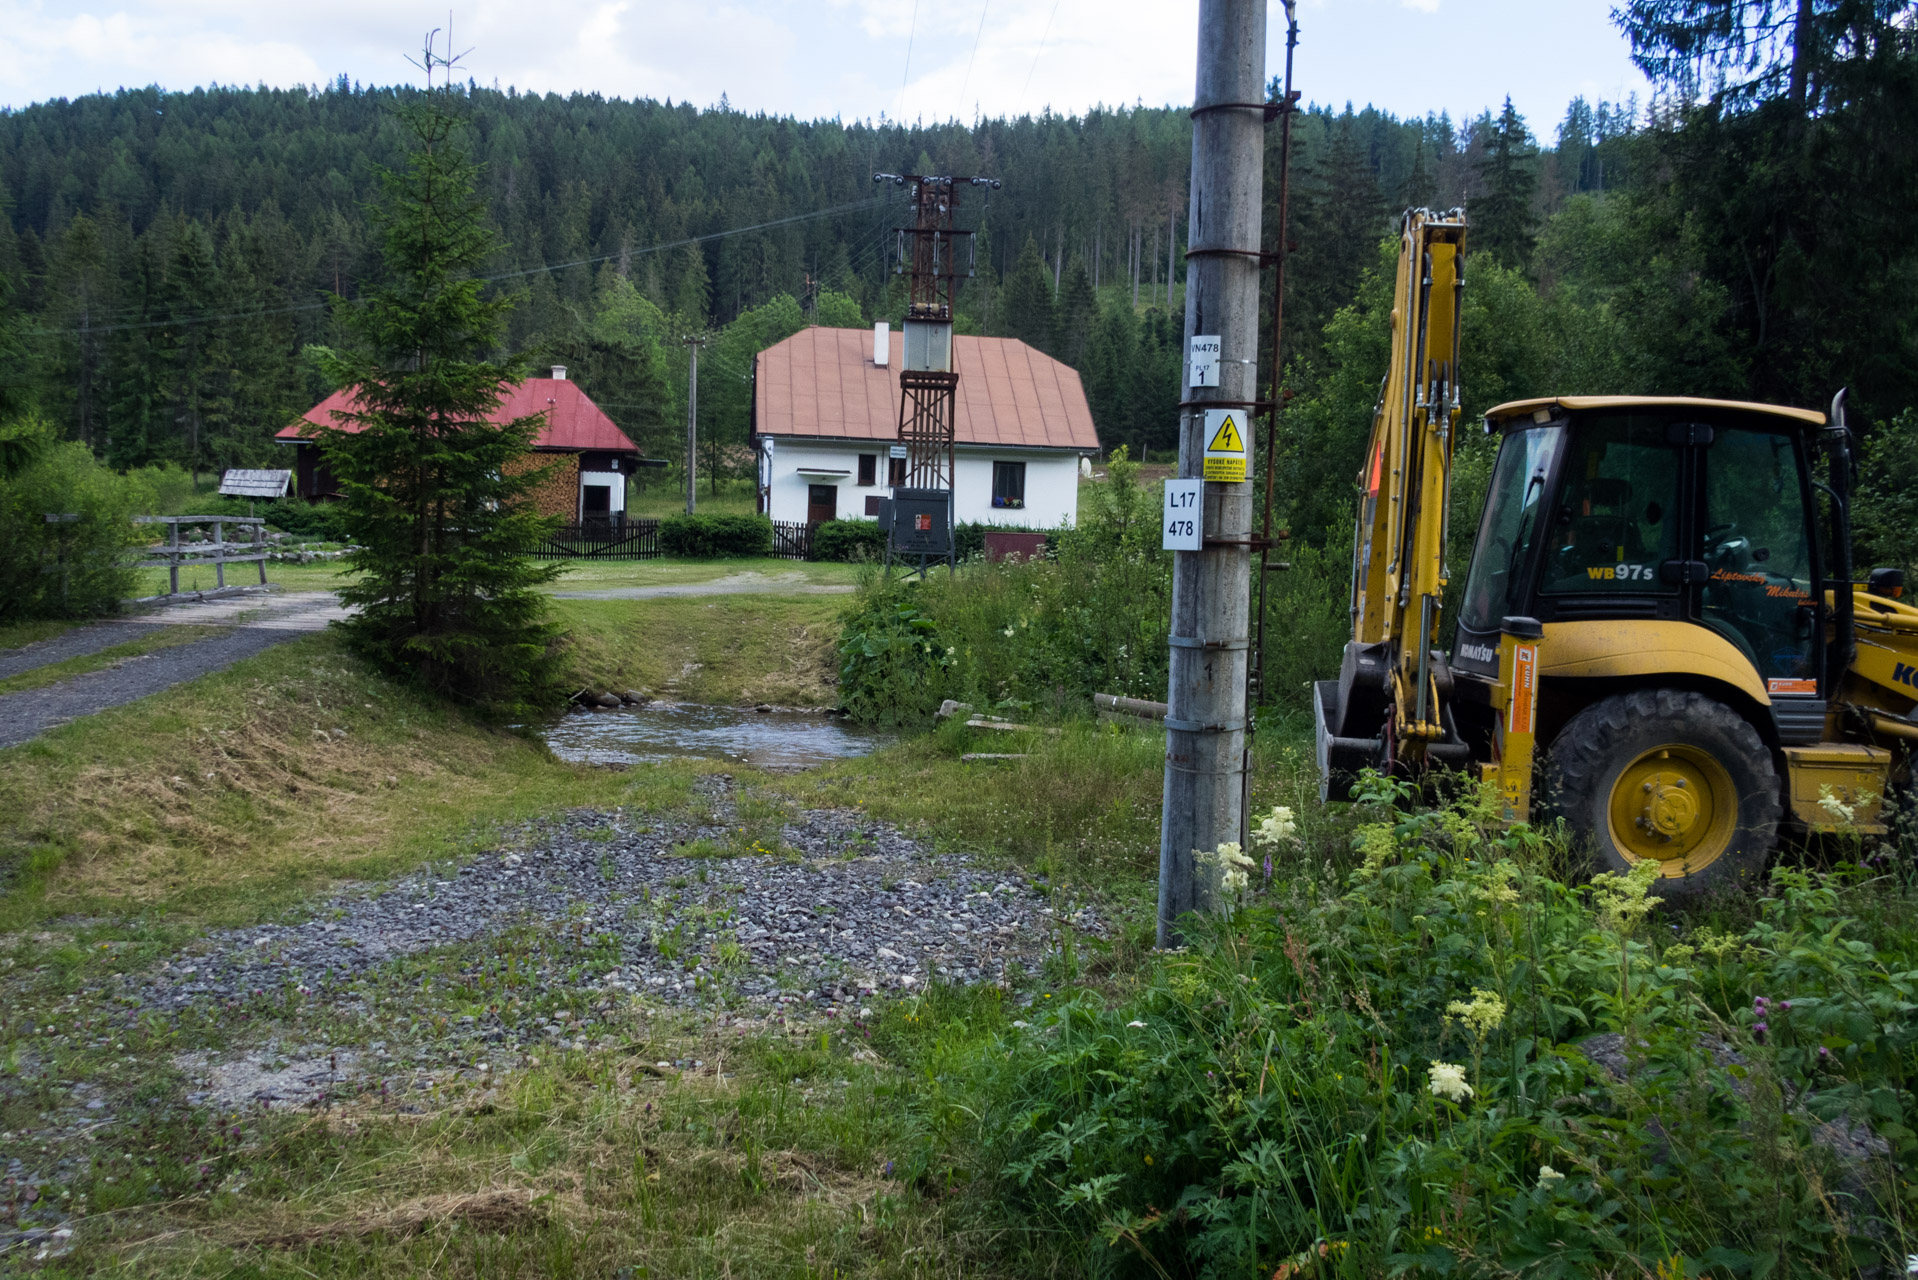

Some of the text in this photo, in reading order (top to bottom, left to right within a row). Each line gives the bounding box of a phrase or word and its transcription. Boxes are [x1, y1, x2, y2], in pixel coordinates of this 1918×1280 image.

[1191, 343, 1219, 353] VN478
[1198, 370, 1205, 385] 1
[1170, 492, 1196, 508] L17
[1168, 520, 1194, 536] 478
[1460, 642, 1494, 663] KOMATSU
